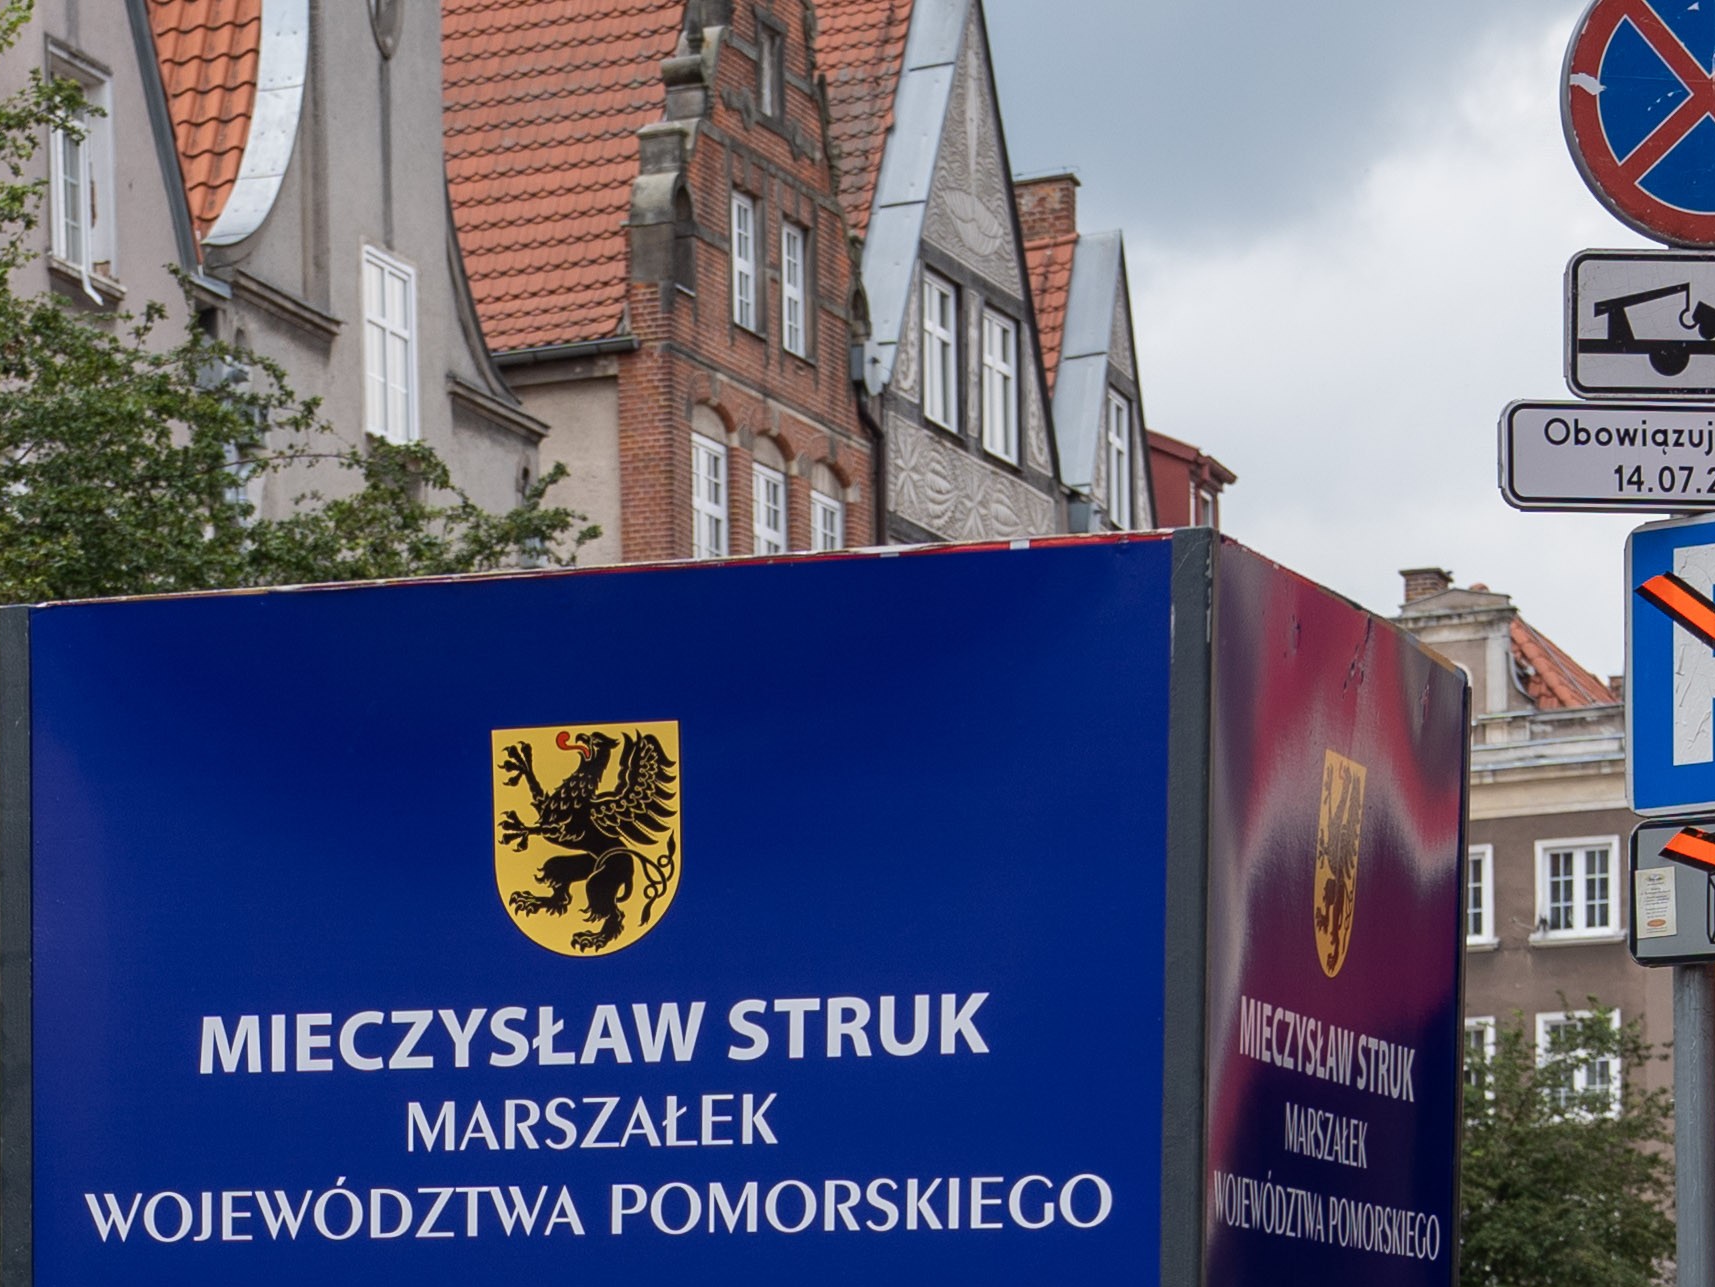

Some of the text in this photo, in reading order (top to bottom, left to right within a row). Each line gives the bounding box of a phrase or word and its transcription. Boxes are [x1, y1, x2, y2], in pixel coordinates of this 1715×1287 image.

[199, 992, 990, 1076] MIECZYSŁAW STRUK
[1239, 995, 1416, 1103] MIECZYSŁAW STRUK
[405, 1092, 779, 1153] MARSZAŁEK
[1284, 1101, 1368, 1169] MARSZAŁEK
[84, 1173, 1115, 1243] WOJEWÓDZTWA POMORSKIEGO
[1214, 1170, 1441, 1261] WOJEWÓDZTWA POMORSKIEGO
